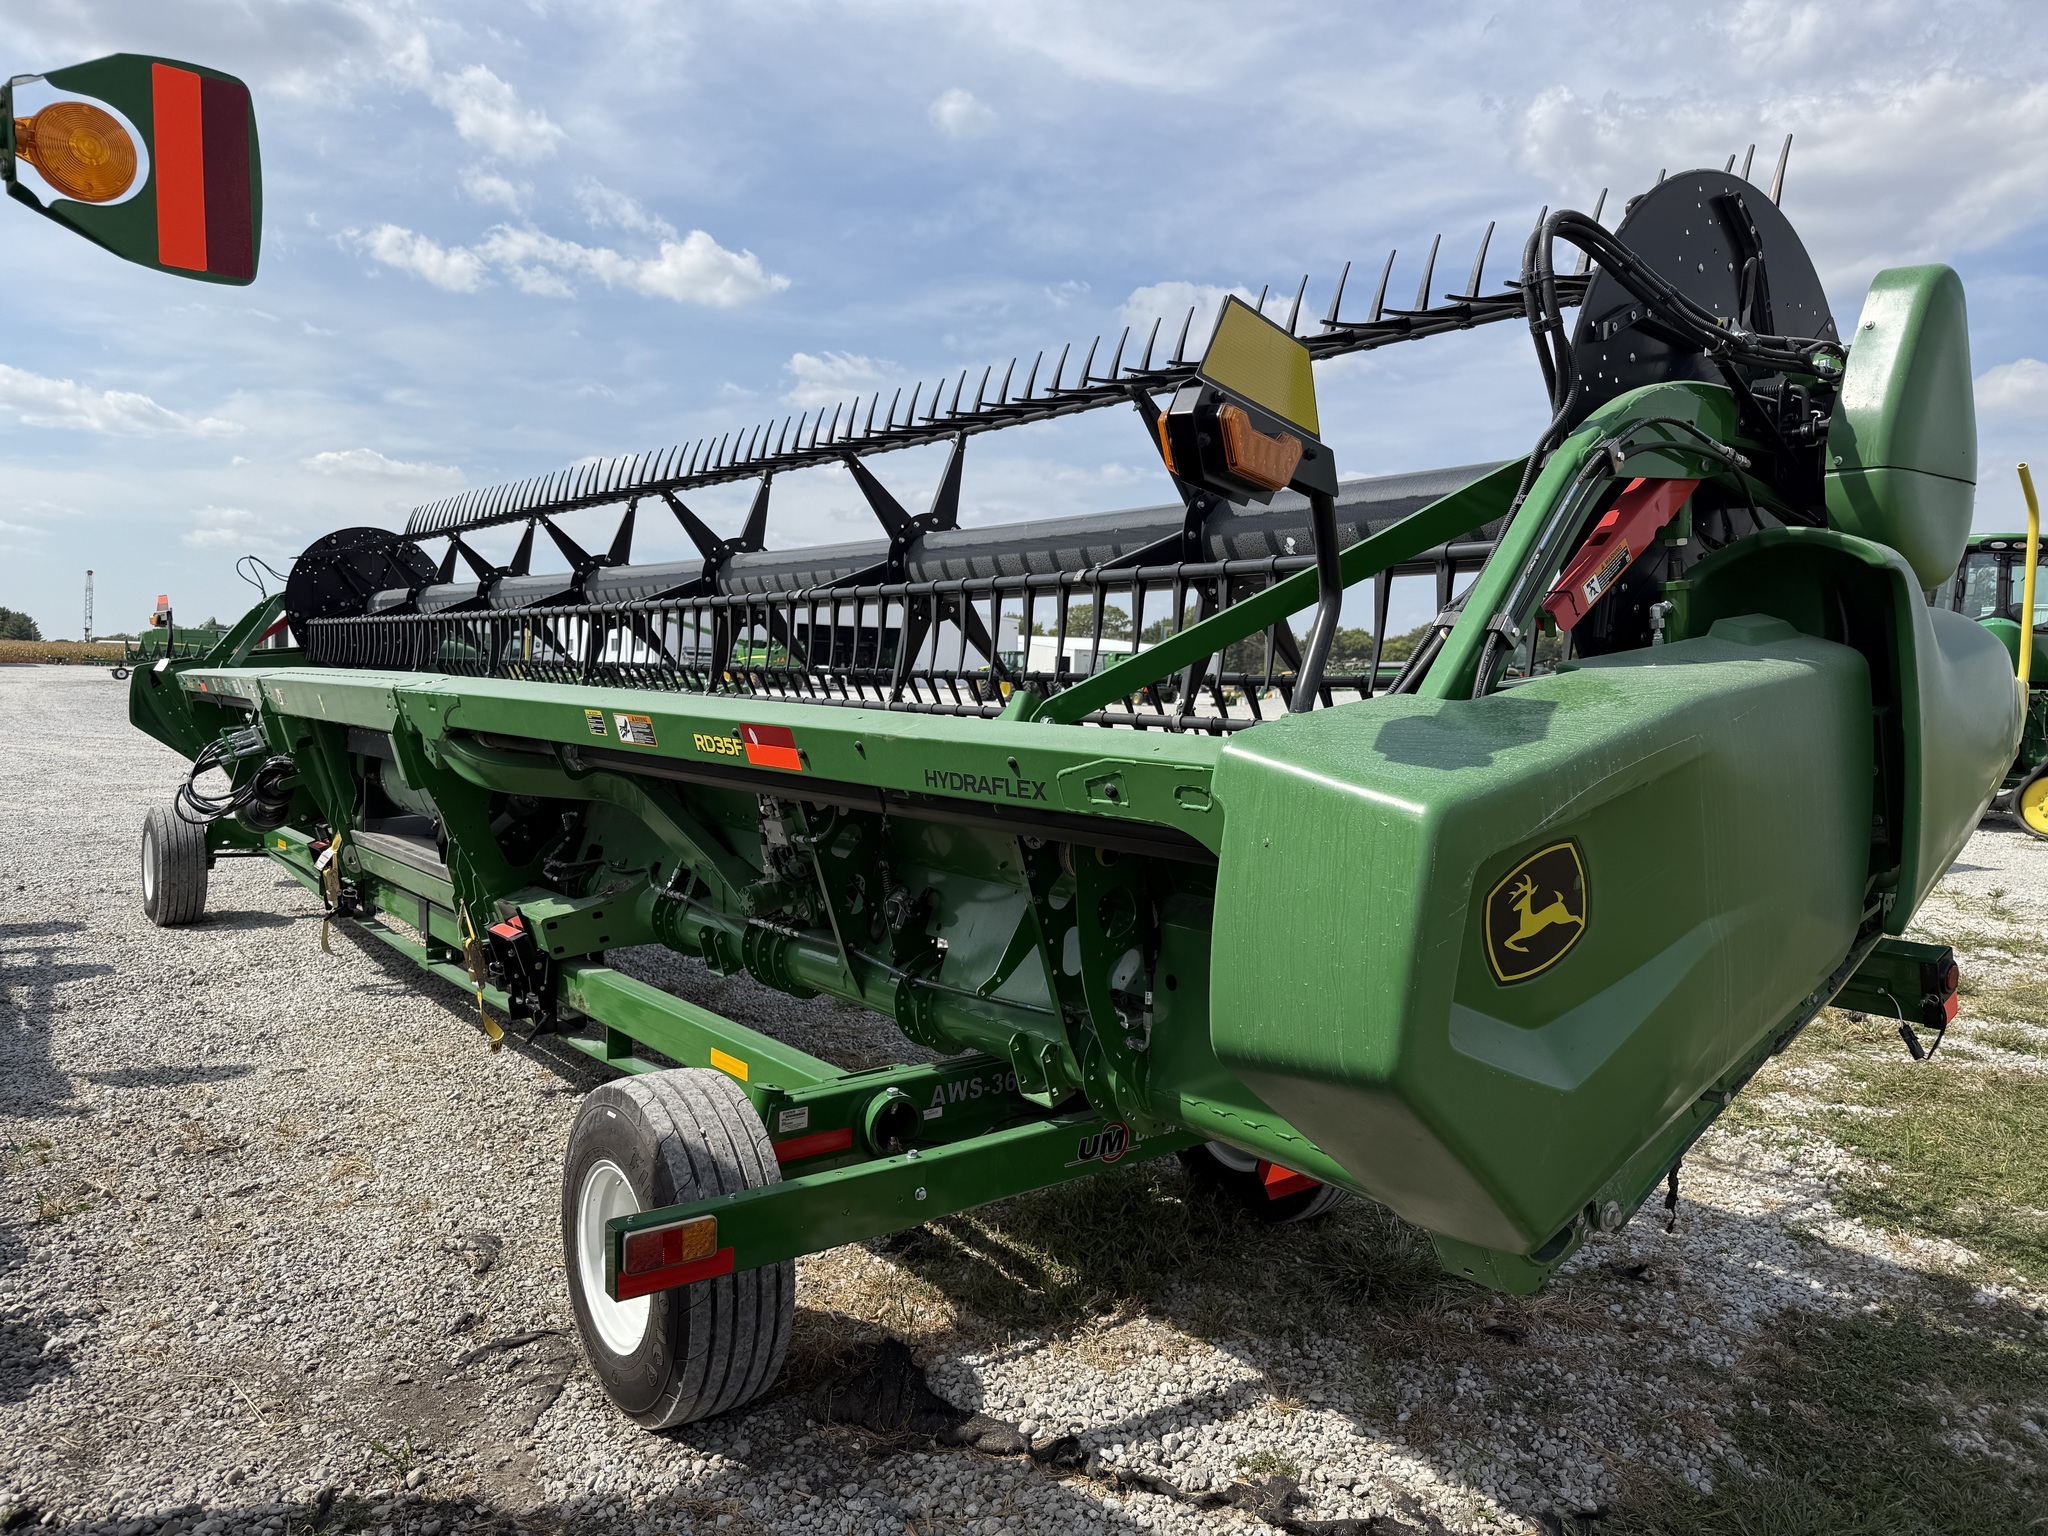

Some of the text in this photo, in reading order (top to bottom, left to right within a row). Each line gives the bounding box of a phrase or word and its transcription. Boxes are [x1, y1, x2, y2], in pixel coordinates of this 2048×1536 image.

[693, 734, 743, 757] RD35F
[924, 769, 1048, 801] HYDRAFLEX
[1078, 1129, 1125, 1160] UM
